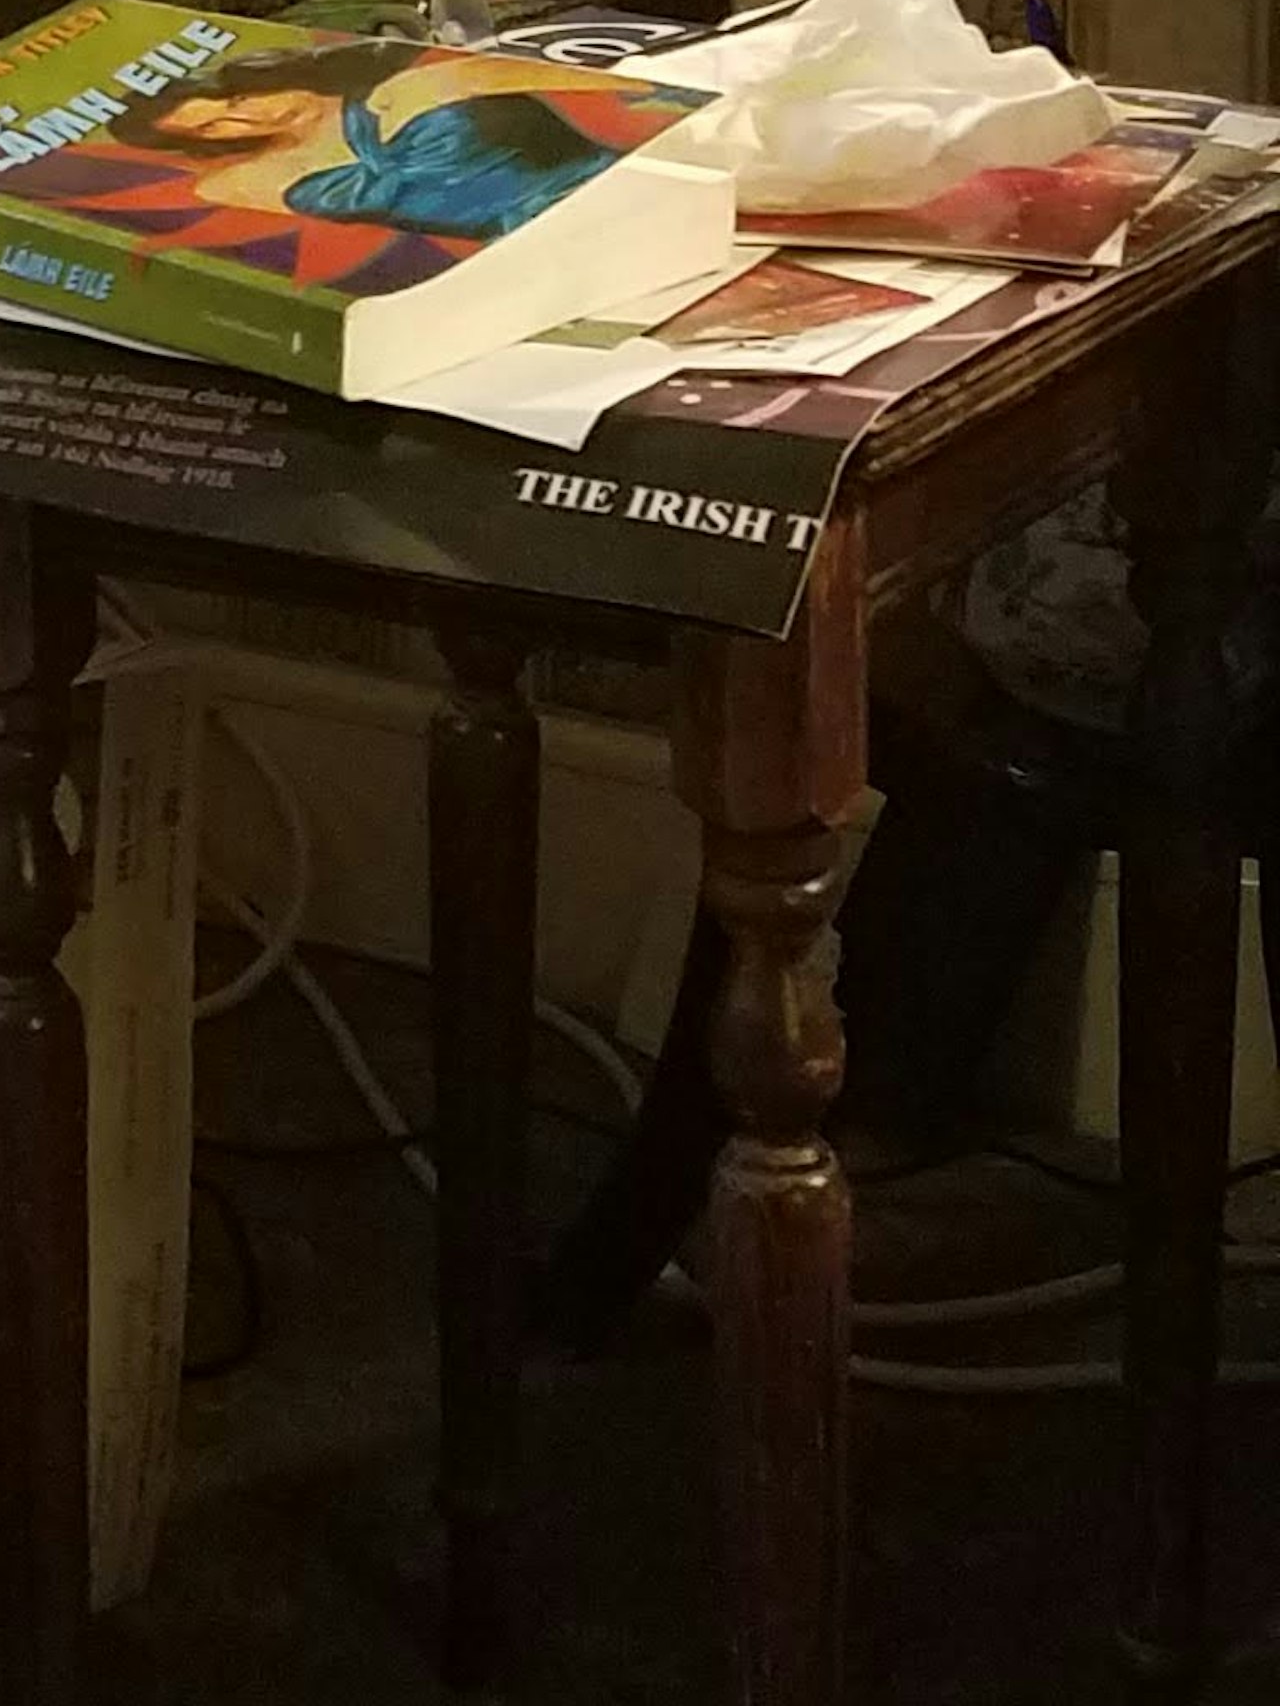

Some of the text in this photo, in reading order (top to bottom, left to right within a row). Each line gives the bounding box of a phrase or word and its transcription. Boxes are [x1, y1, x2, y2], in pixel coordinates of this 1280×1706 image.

[112, 18, 238, 98] EILE
[64, 262, 115, 302] EILE
[513, 467, 619, 514] THE
[624, 485, 777, 544] IRISH
